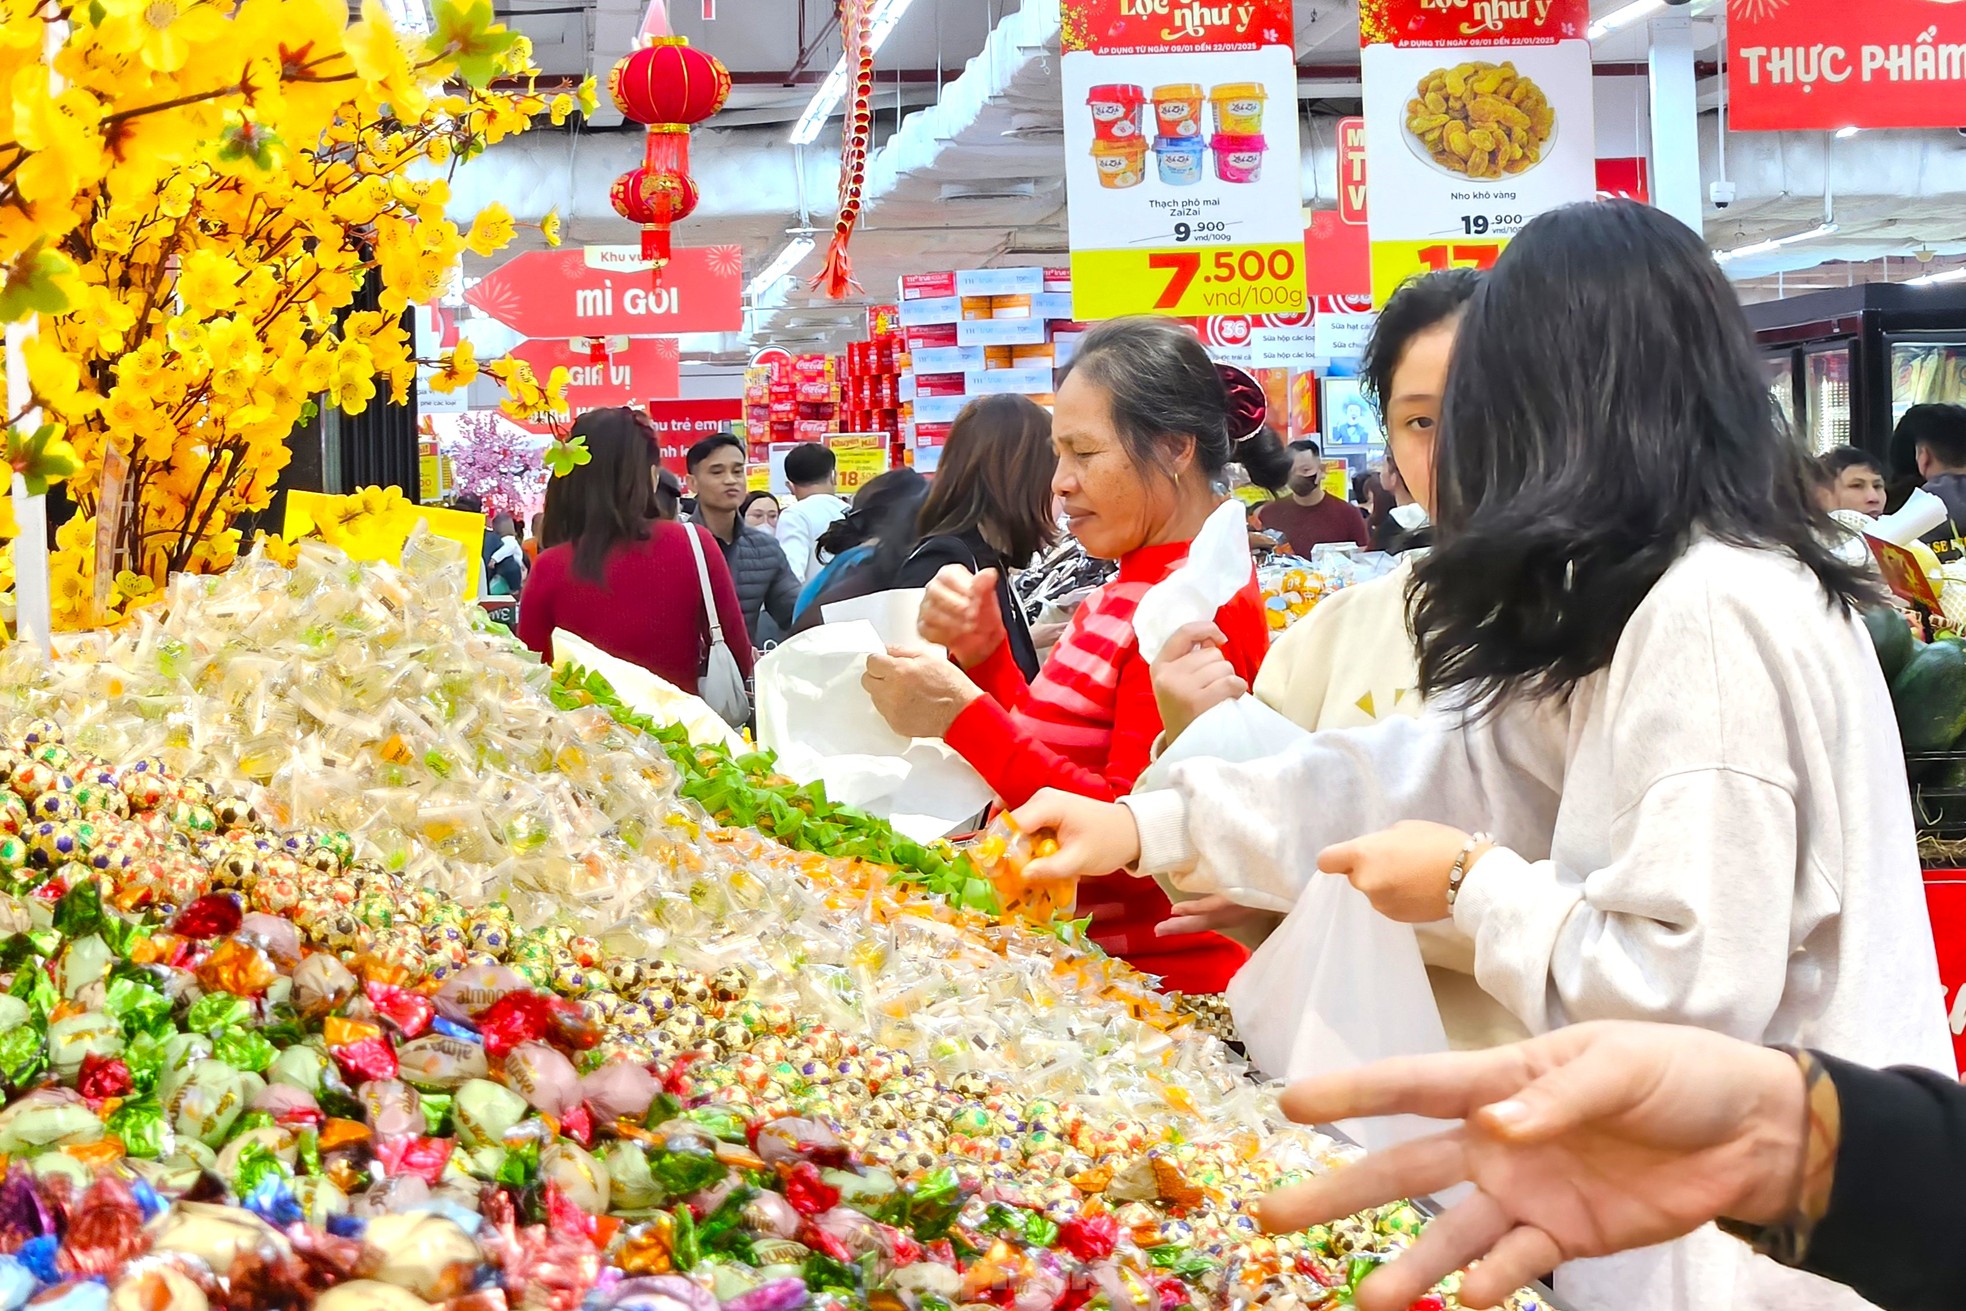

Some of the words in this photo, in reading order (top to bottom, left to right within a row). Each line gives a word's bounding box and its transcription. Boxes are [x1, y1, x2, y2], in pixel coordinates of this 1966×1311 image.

[1111, 46, 1134, 55] DỤNG
[1148, 44, 1169, 53] NGÀY
[1171, 44, 1193, 53] 09/01
[1195, 42, 1212, 52] ĐẾN
[1213, 42, 1257, 51] 22/01/2025
[1739, 43, 1852, 93] THỰC
[1860, 24, 1966, 82] PHẨM
[1149, 198, 1179, 209] Thạch
[1181, 197, 1200, 208] phô
[1203, 197, 1220, 206] mai
[1451, 192, 1470, 200] Nho
[1473, 191, 1491, 200] khô
[1493, 191, 1516, 201] vàng
[1170, 207, 1201, 217] ZaiZai
[1174, 222, 1191, 242] 9
[1461, 214, 1489, 235] 19
[1194, 233, 1231, 242] vnd/100g
[600, 252, 626, 262] Khu
[1148, 252, 1201, 309] 7
[1203, 285, 1302, 308] vnd/100g
[1222, 320, 1247, 338] 36
[839, 471, 858, 486] 18
